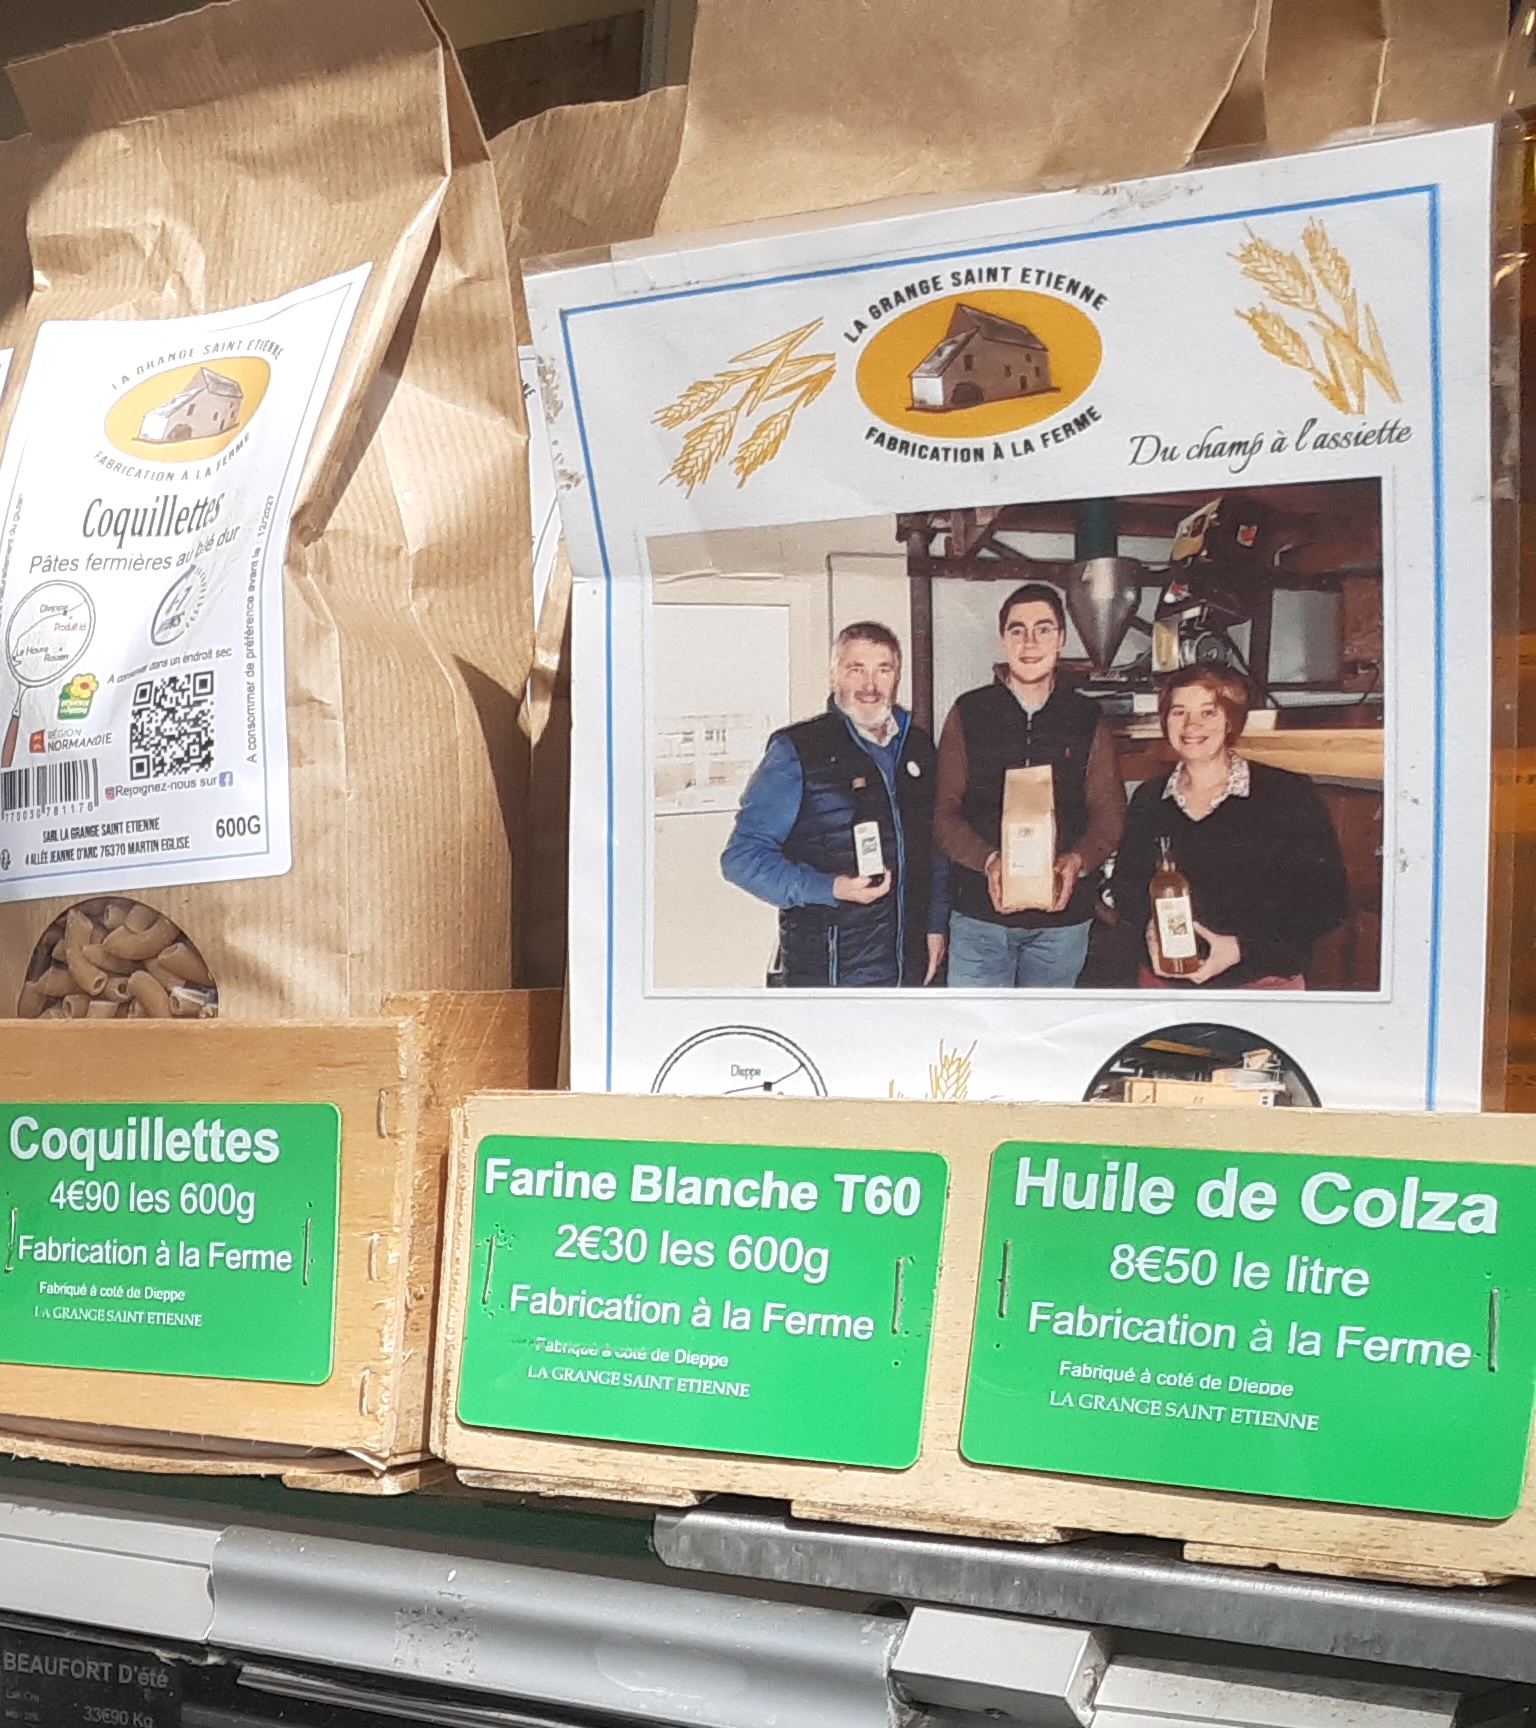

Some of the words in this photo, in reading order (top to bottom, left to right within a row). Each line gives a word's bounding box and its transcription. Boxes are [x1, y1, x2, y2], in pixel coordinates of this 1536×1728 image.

[844, 315, 868, 345] LA
[867, 276, 945, 321] GRANGE
[950, 266, 1012, 288] SAINT
[1020, 267, 1109, 312] ETIENNE
[863, 425, 987, 463] FABRICATION
[992, 441, 1005, 461] À
[1009, 436, 1036, 457] LA
[1040, 405, 1103, 450] FERME
[1128, 434, 1180, 468] Du
[1185, 425, 1264, 474] champ
[1270, 429, 1289, 452] à
[1293, 417, 1414, 452] l'assiette
[83, 493, 225, 550] Coquillettes
[215, 815, 261, 839] 600G
[729, 1063, 762, 1080] Dieppe
[9, 1116, 280, 1172] Coquillettes
[50, 1180, 120, 1212] 4€90
[129, 1182, 170, 1214] les
[180, 1182, 256, 1224] 600g
[484, 1157, 617, 1202] Farine
[630, 1164, 818, 1212] Blanche
[834, 1173, 922, 1217] T60
[1013, 1156, 1175, 1216] Huile
[1196, 1167, 1278, 1222] de
[1301, 1171, 1499, 1235] Colza
[18, 1235, 147, 1266] Fabrication
[155, 1241, 170, 1267] à
[179, 1242, 200, 1268] la
[209, 1242, 292, 1272] Ferme
[554, 1224, 648, 1264] 2€30
[660, 1230, 715, 1269] les
[728, 1235, 830, 1285] 600g
[1109, 1244, 1218, 1288] 8€50
[1233, 1251, 1270, 1290] le
[1286, 1254, 1371, 1298] litre
[510, 1284, 681, 1326] Fabrication
[692, 1297, 712, 1328] à
[723, 1300, 751, 1331] la
[763, 1302, 874, 1340] Ferme
[1028, 1301, 1236, 1350] Fabrication
[1250, 1320, 1272, 1353] à
[1288, 1322, 1322, 1356] la
[1337, 1326, 1472, 1370] Ferme
[1058, 1359, 1136, 1386] Fabriqué
[1140, 1368, 1152, 1385] à
[1156, 1370, 1195, 1389] coté
[1199, 1373, 1223, 1391] de
[1228, 1376, 1294, 1397] Dieppe
[3, 1651, 113, 1682] BEAUFORT
[118, 1664, 169, 1688] D'été
[83, 1706, 129, 1726] 33€90
